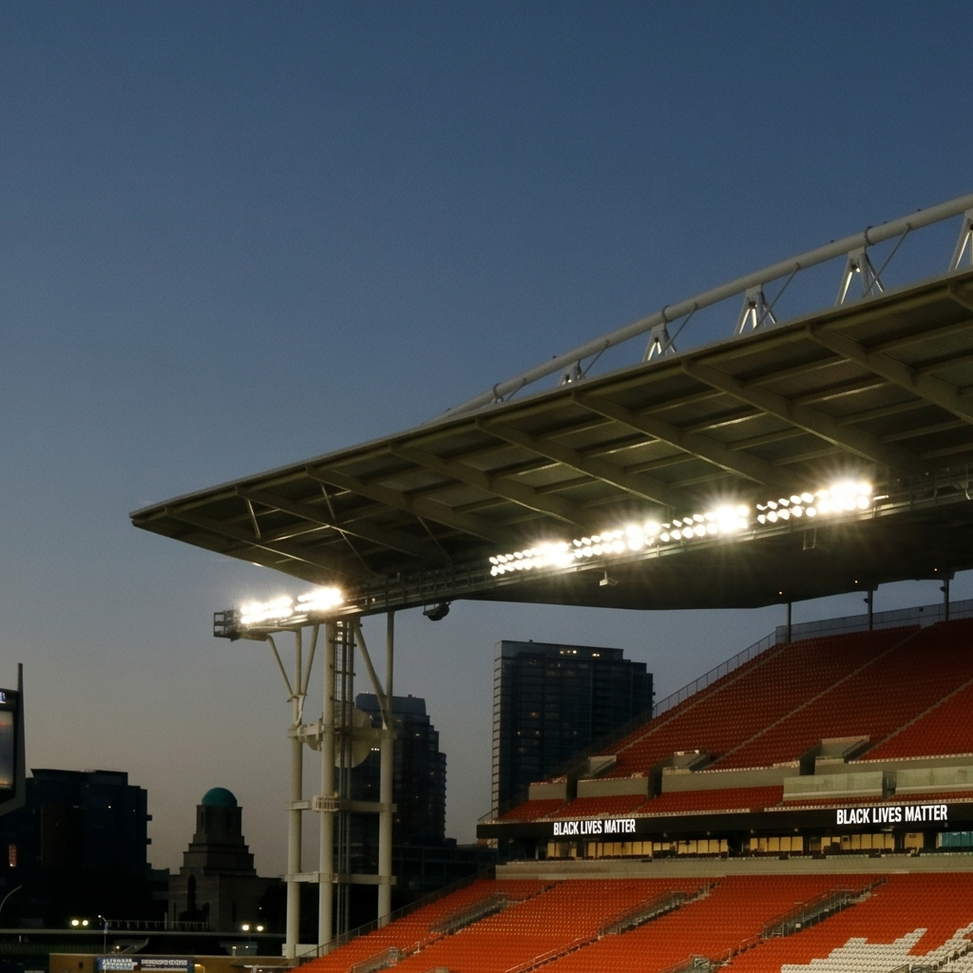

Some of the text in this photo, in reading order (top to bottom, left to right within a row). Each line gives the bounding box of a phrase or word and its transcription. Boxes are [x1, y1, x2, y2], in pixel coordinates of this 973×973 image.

[837, 805, 947, 824] BLACK LIVES MATTER
[554, 819, 636, 835] BLACK LIVES MATTER
